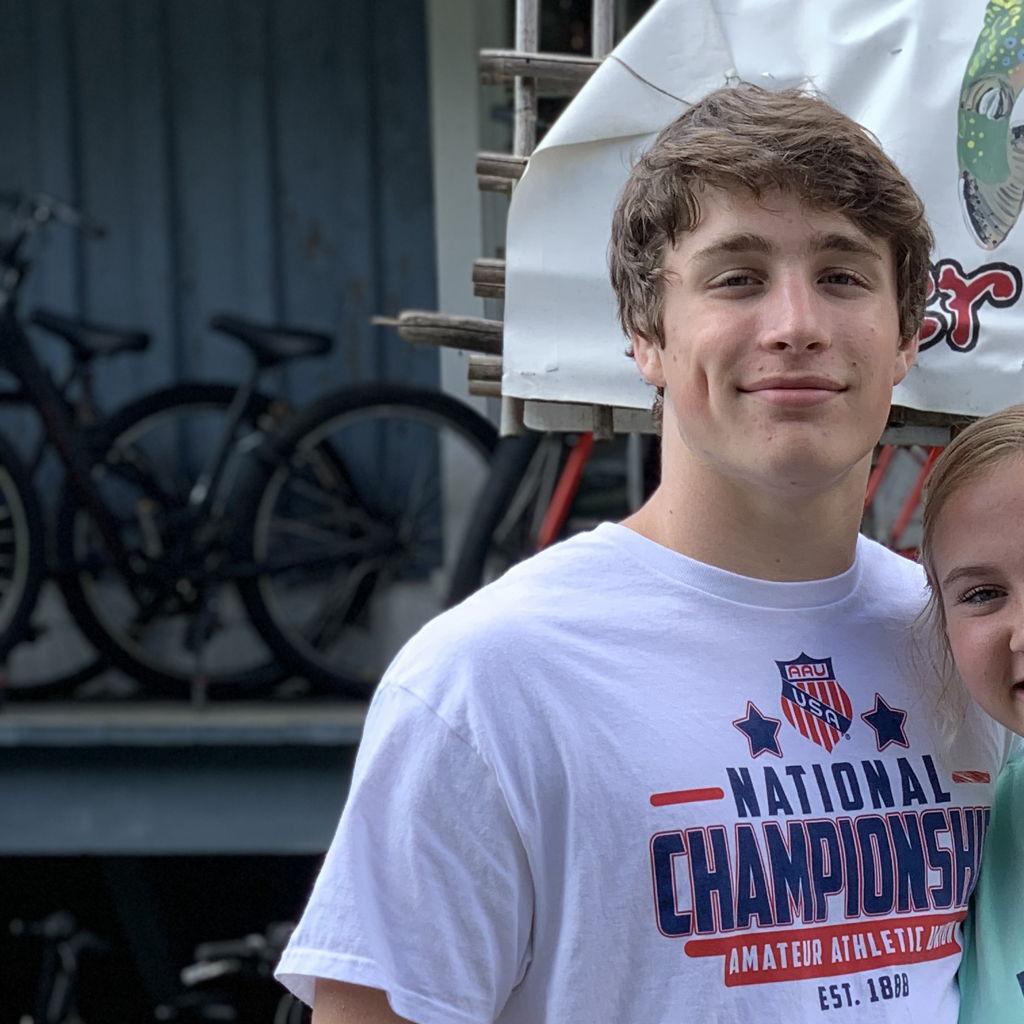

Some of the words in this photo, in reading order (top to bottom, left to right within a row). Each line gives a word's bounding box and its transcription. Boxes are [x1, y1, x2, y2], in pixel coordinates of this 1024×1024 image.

[787, 663, 827, 678] AAU
[791, 687, 841, 730] USA
[726, 755, 951, 818] NATIONAL
[650, 806, 991, 938] CHAMPIONSHI
[729, 938, 822, 975] AMATEUR
[831, 926, 924, 963] ATHLETIC
[818, 983, 861, 1011] EST.
